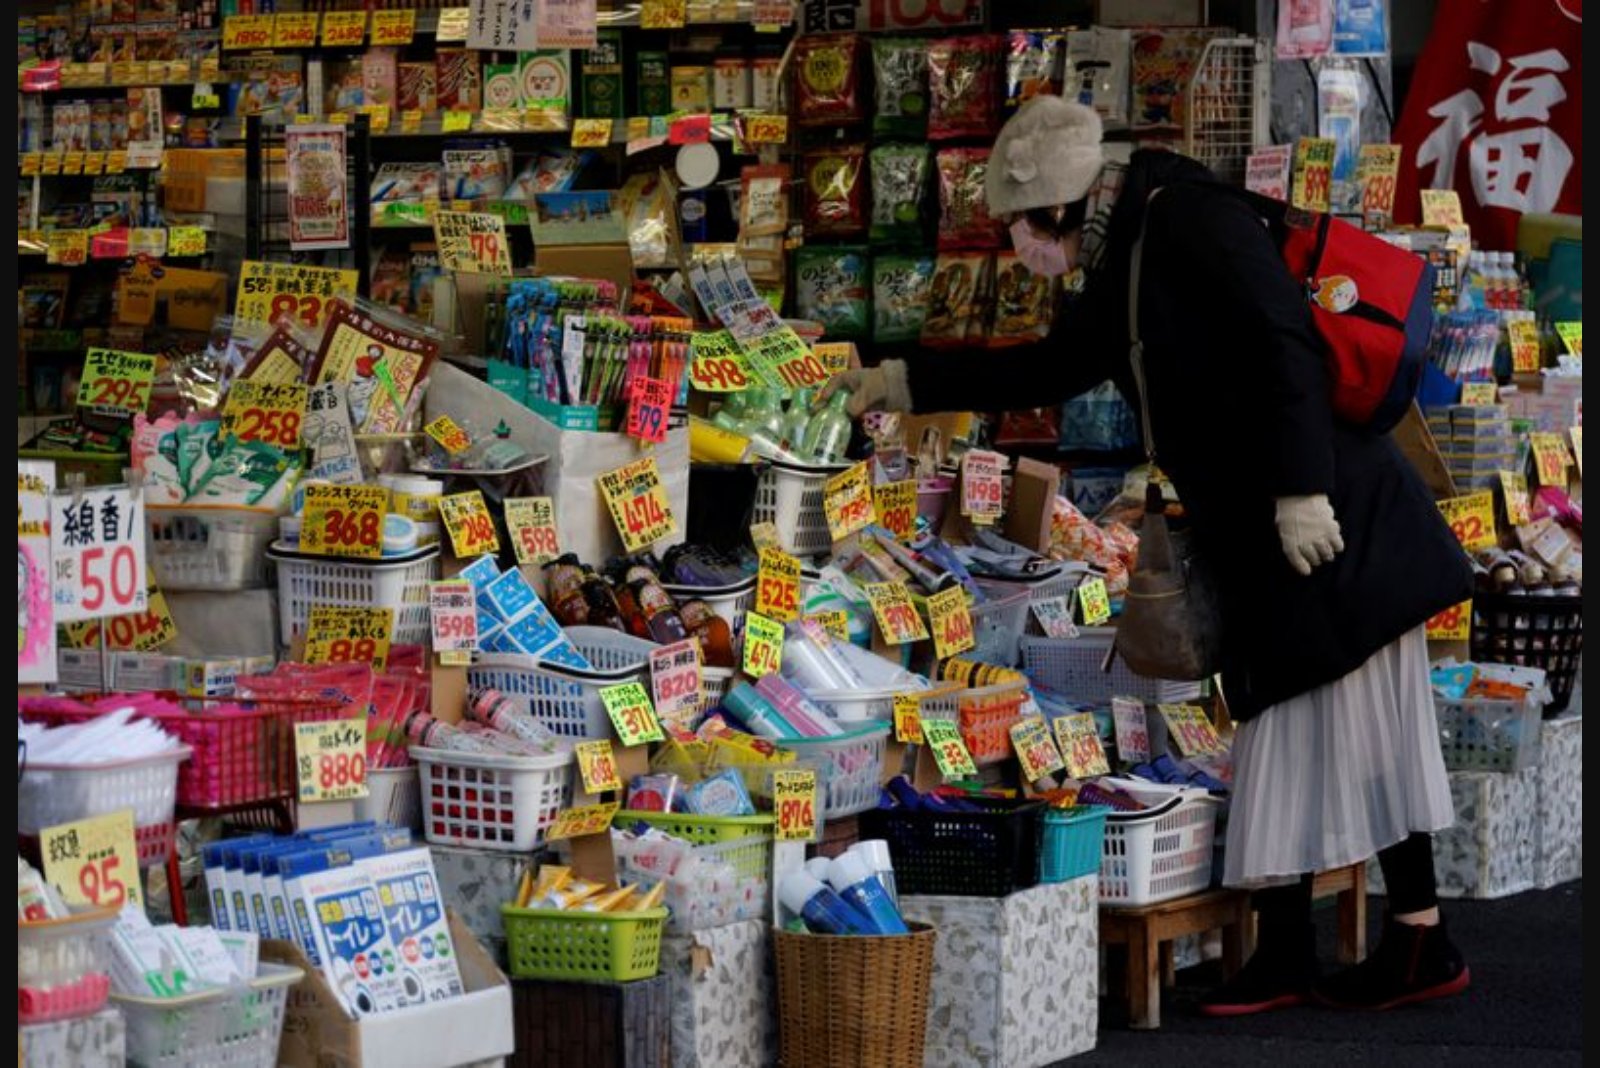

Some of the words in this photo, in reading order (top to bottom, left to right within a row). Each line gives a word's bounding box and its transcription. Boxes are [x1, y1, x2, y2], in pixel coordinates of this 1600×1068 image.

[1416, 41, 1573, 215] 福
[470, 234, 499, 264] 79
[692, 358, 746, 388] 498
[778, 355, 825, 389] 1180
[91, 377, 148, 409] 295
[240, 408, 299, 446] 258
[971, 482, 999, 502] 198
[323, 510, 379, 546] 368
[623, 492, 665, 535] 474
[519, 527, 558, 555] 598
[80, 545, 137, 611] 50
[760, 577, 797, 611] 525
[438, 615, 475, 637] 598
[658, 671, 698, 699] 820
[320, 752, 365, 789] 880
[779, 799, 812, 829] 876
[79, 856, 125, 906] 95
[326, 921, 370, 954] トイレ
